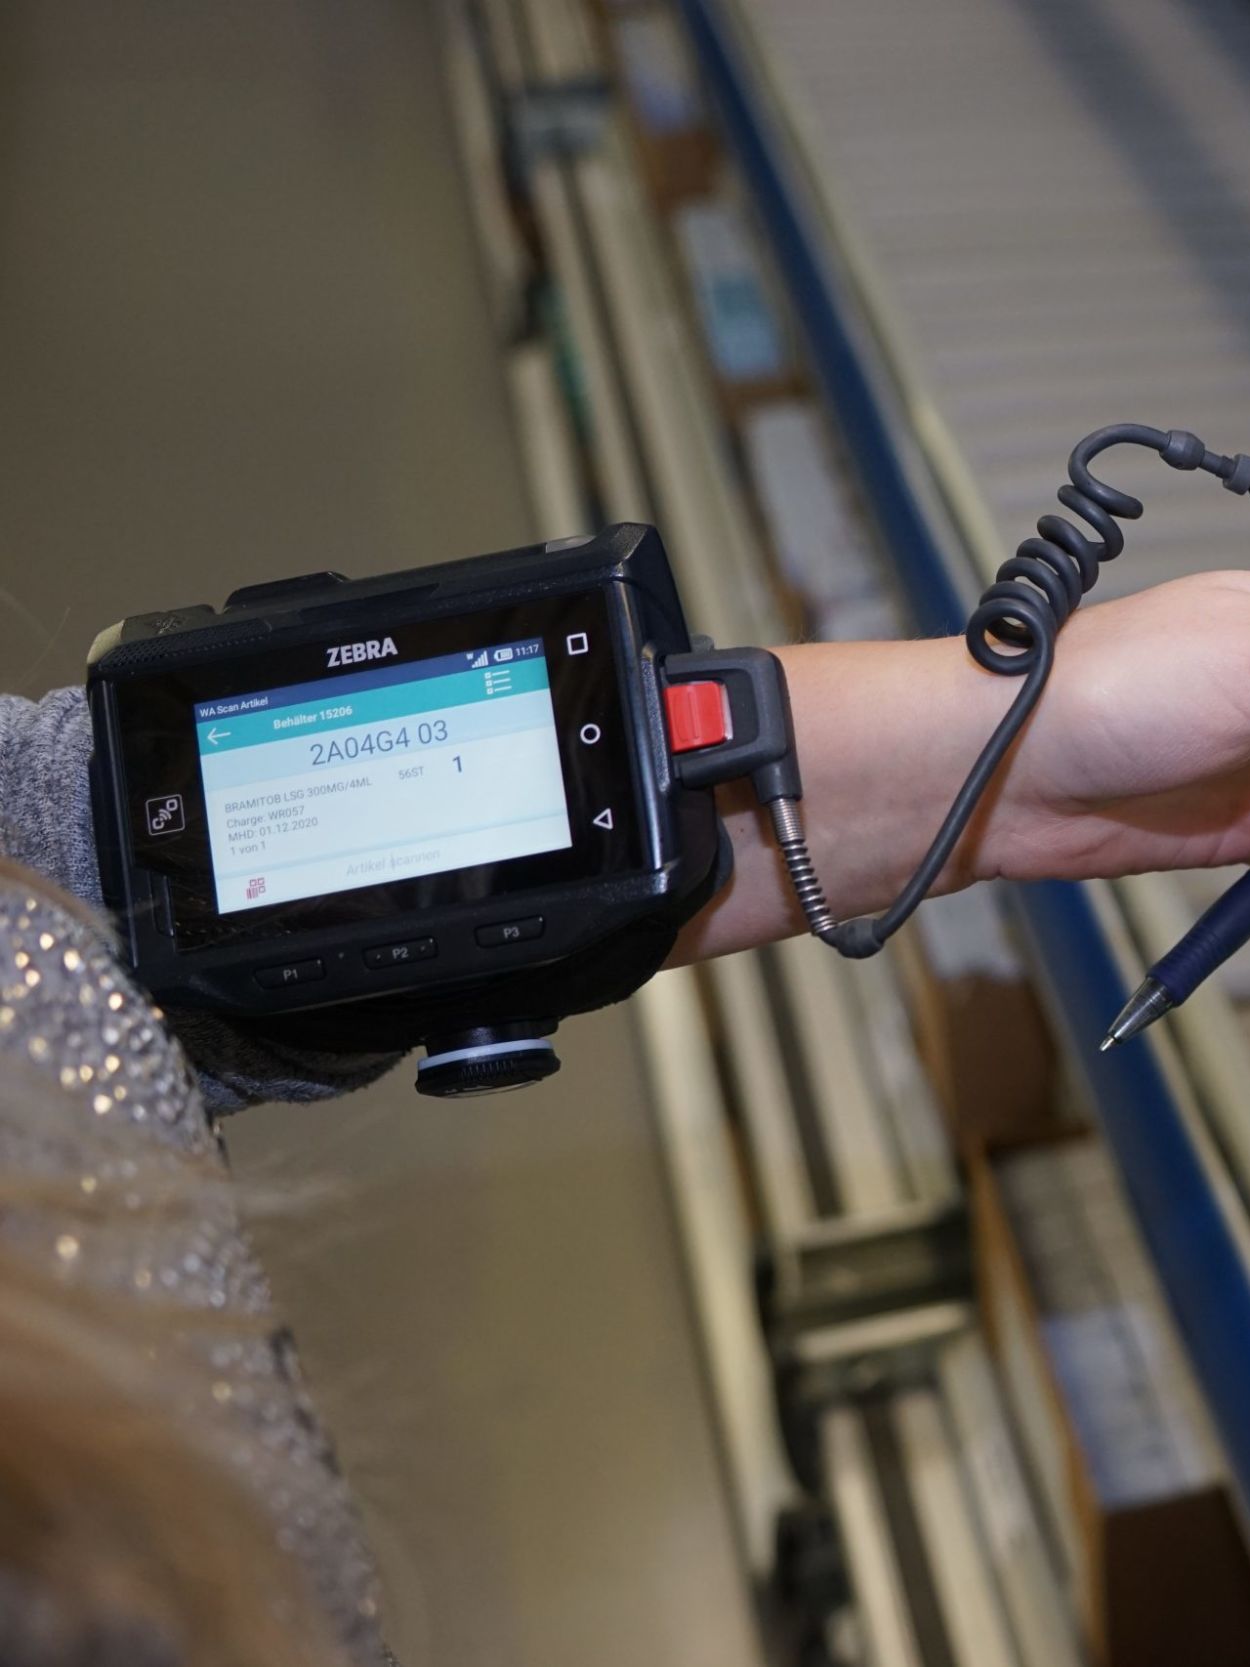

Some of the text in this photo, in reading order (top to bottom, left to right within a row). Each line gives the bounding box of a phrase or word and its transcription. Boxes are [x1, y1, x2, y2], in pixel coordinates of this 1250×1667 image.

[327, 637, 398, 667] ZEBRA
[515, 644, 539, 656] 11:17
[200, 697, 269, 718] WA Scan Artikel
[273, 705, 353, 729] Behälter 15206
[310, 719, 448, 766] 2A04G4 03
[224, 755, 463, 814] BRAMITOB LSG 300MG/4ML 56ST 1
[226, 805, 305, 830] Charge: WR057
[228, 816, 319, 843] MHD: 01.12.2020
[239, 844, 258, 854] von
[346, 858, 386, 876] Artikel
[503, 926, 520, 939] P3
[392, 948, 408, 960] P2
[283, 969, 298, 981] P1
